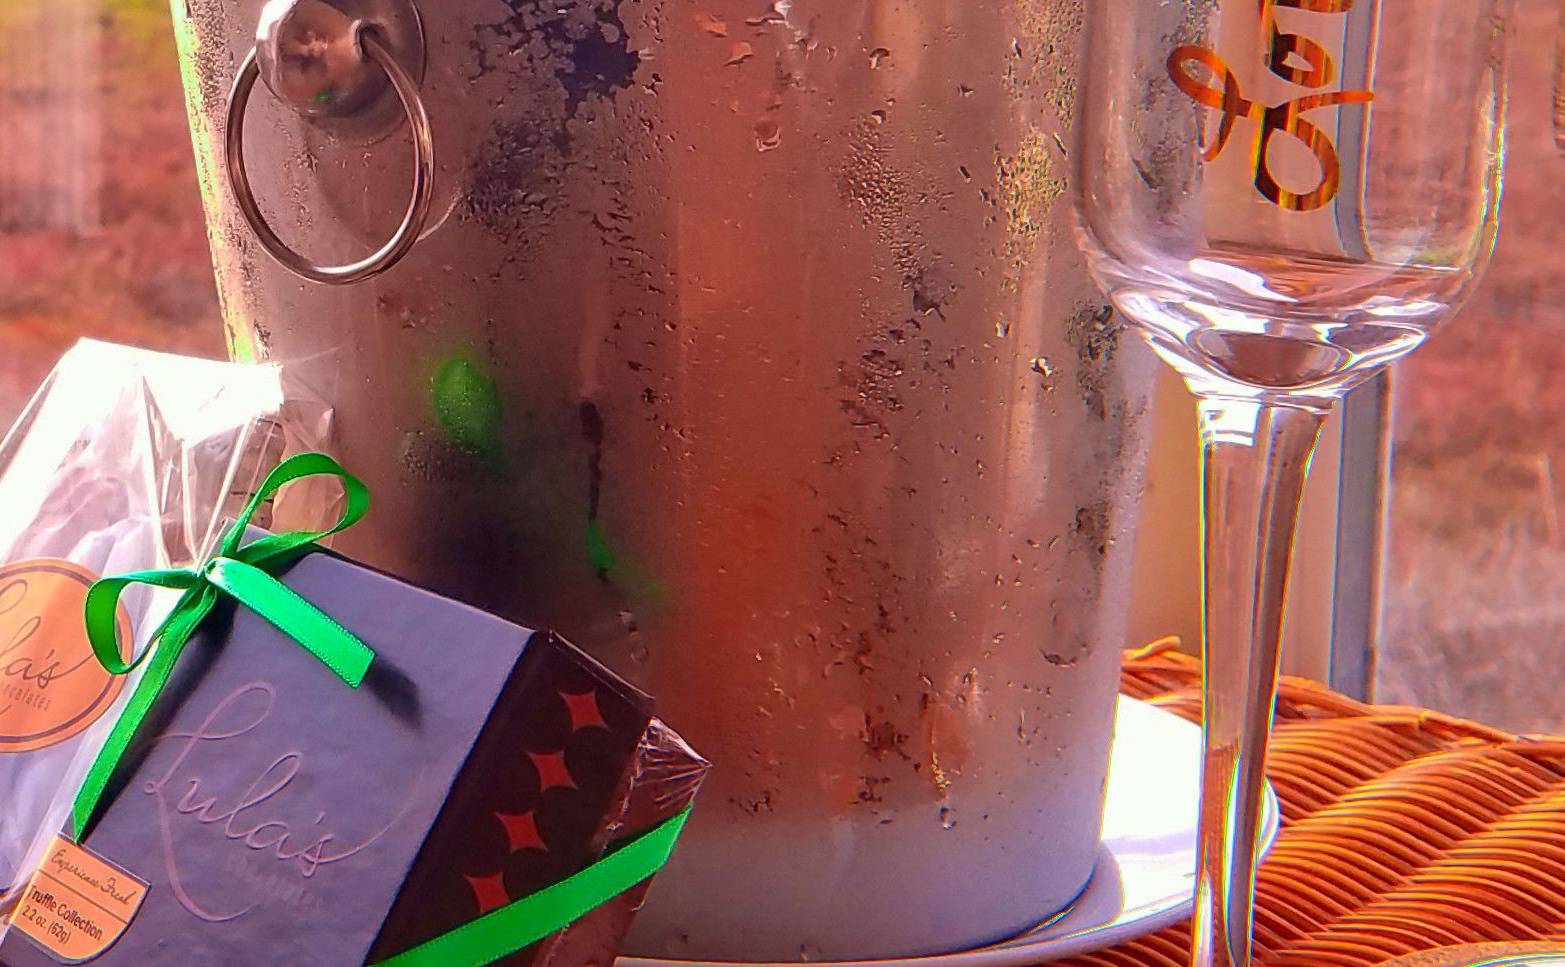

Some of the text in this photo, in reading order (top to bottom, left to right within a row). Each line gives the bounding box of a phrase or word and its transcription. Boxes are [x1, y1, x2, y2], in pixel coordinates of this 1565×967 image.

[138, 682, 413, 922] Lula's
[28, 885, 103, 941] Truffle Collection
